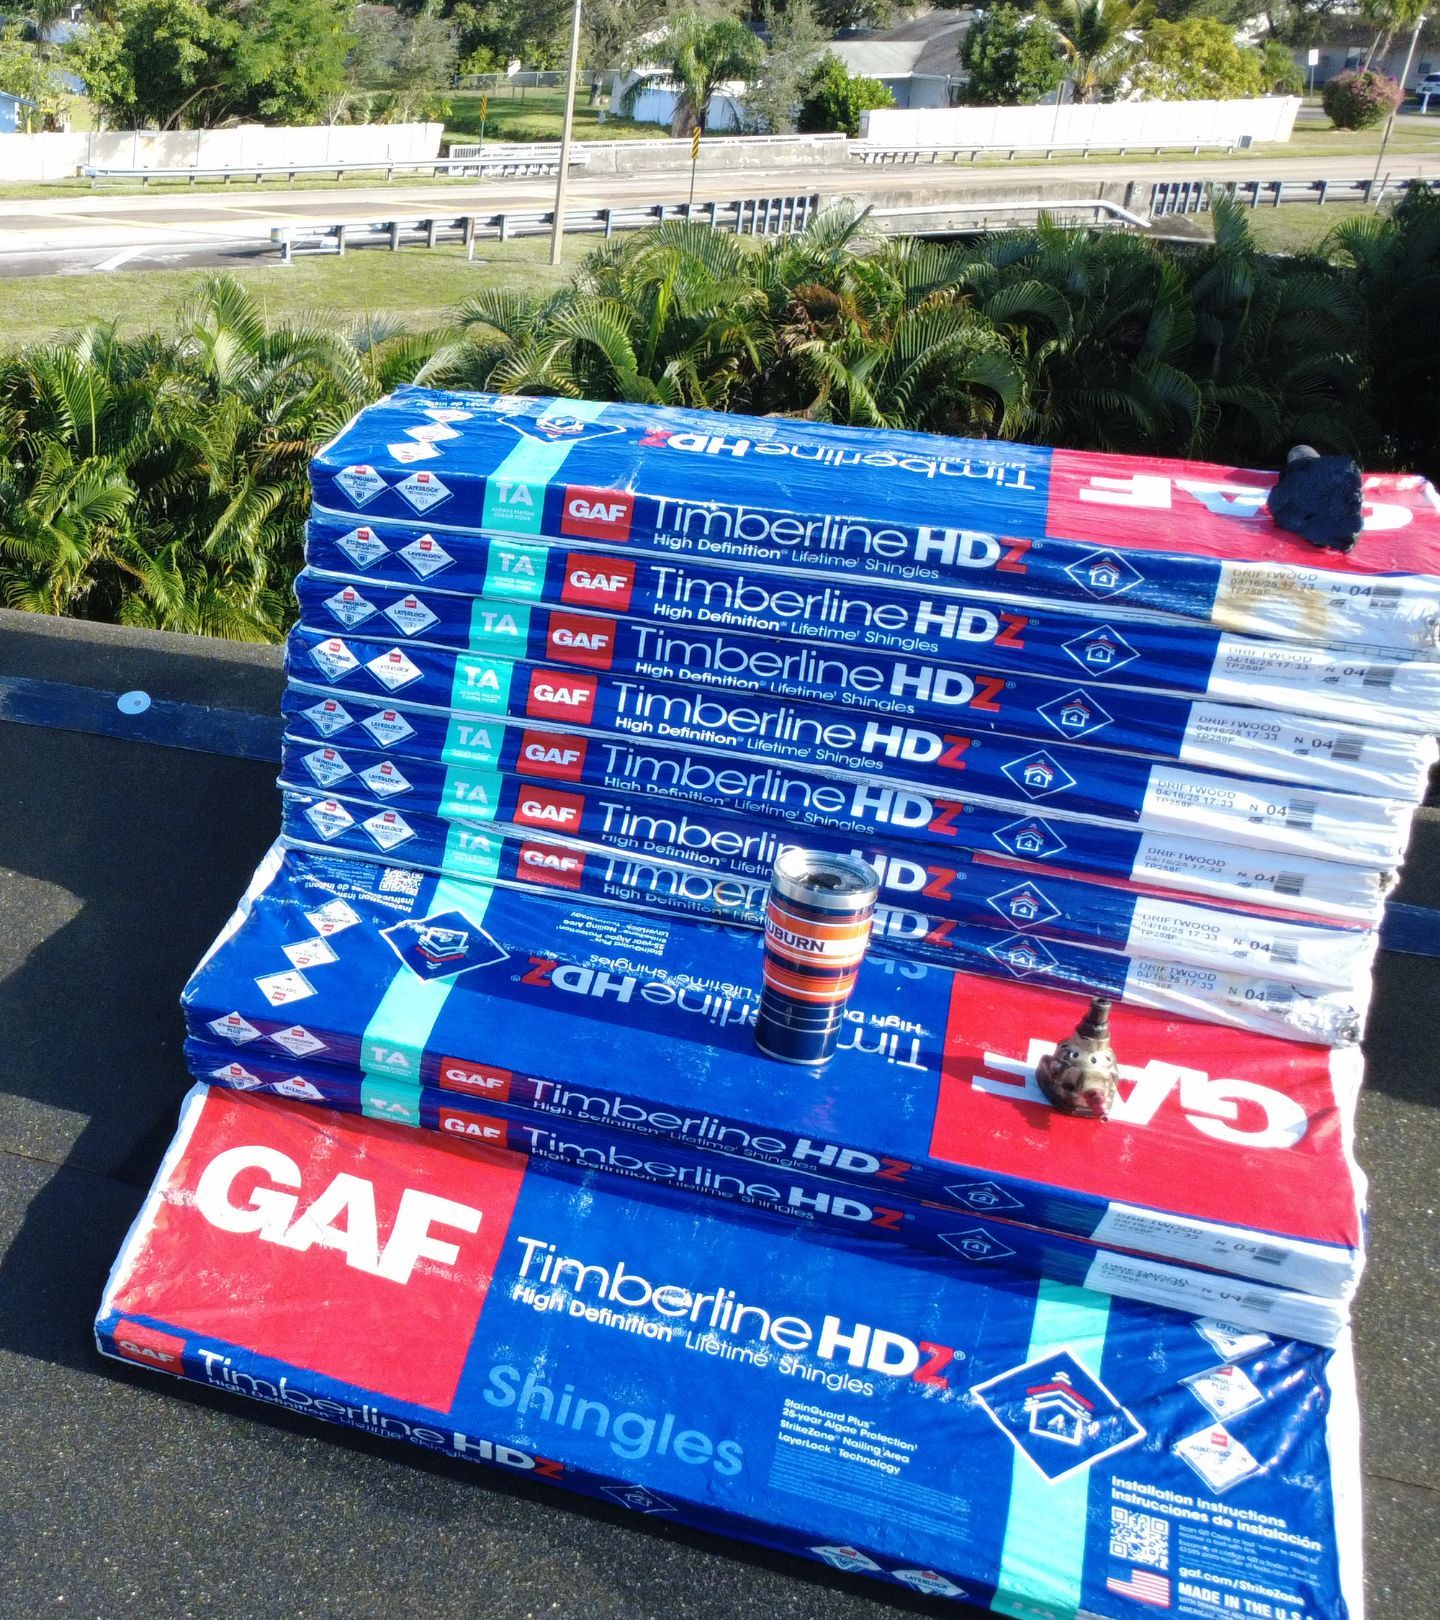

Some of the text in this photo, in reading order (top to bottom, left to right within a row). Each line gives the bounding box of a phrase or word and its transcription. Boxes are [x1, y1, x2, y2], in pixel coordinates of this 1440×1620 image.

[639, 429, 1037, 491] Timberline HDZ
[497, 481, 534, 506] TA
[568, 499, 627, 522] GAF
[654, 498, 1033, 575] Timberline HDZ
[498, 551, 536, 577] TA
[654, 532, 940, 580] High Definition Lifetime Shingles
[569, 570, 628, 592] GAF
[1349, 585, 1373, 597] 04
[650, 565, 1029, 650] Timberline HDZ
[481, 611, 518, 636] TA
[654, 602, 939, 653] High Definition Lifetime Shingles
[551, 628, 609, 650] GAF
[463, 665, 499, 690] TA
[631, 625, 1006, 713] Timberline HDZ
[1343, 666, 1366, 676] 04
[533, 684, 590, 706] GAF
[635, 661, 915, 715] High Definition Lifetime Shingles
[457, 726, 492, 749] TA
[612, 681, 972, 770] Timberline HDZ
[525, 744, 580, 766] GAF
[616, 717, 884, 771] High Definition Lifetime Shingles
[1311, 738, 1334, 750] 04
[454, 782, 489, 805] TA
[602, 743, 964, 837] Timberline HDZ
[521, 801, 577, 823] GAF
[646, 783, 875, 836] Definition Lifetime Shingles
[1266, 804, 1288, 817] 04
[523, 850, 579, 872] GAF
[643, 841, 720, 866] Definition
[1254, 872, 1276, 883] 04
[603, 884, 641, 901] High
[766, 921, 826, 953] UBURN
[1250, 941, 1271, 953] 04
[590, 953, 668, 979] Shingles
[520, 956, 636, 1003] HDZ
[1245, 988, 1265, 1002] 04
[370, 1047, 409, 1067] TA
[445, 1068, 505, 1089] GAF
[444, 1117, 501, 1139] GAF
[527, 1077, 911, 1182] Timberline HDZ
[532, 1100, 817, 1172] High Definition Shingles
[522, 1124, 905, 1232] Timberline HDZ
[194, 1145, 483, 1285] GAF
[517, 1235, 955, 1390] Timberline HDZ
[119, 1339, 175, 1363] GAF
[512, 1284, 874, 1397] High Definition Lifetime Shingles
[198, 1348, 566, 1480] Timberline HDZ
[483, 1364, 744, 1477] Shingles
[784, 1398, 845, 1422] StainGuard
[780, 1419, 910, 1464] StrikeZone Nailing Area
[782, 1407, 916, 1452] 25-year Algae Protection
[778, 1431, 901, 1475] LayerLock Technology
[1111, 1475, 1194, 1507] Installation
[1212, 1512, 1234, 1528] de
[1178, 1582, 1220, 1604] MADE
[1224, 1593, 1240, 1609] IN
[1243, 1598, 1271, 1618] THE
